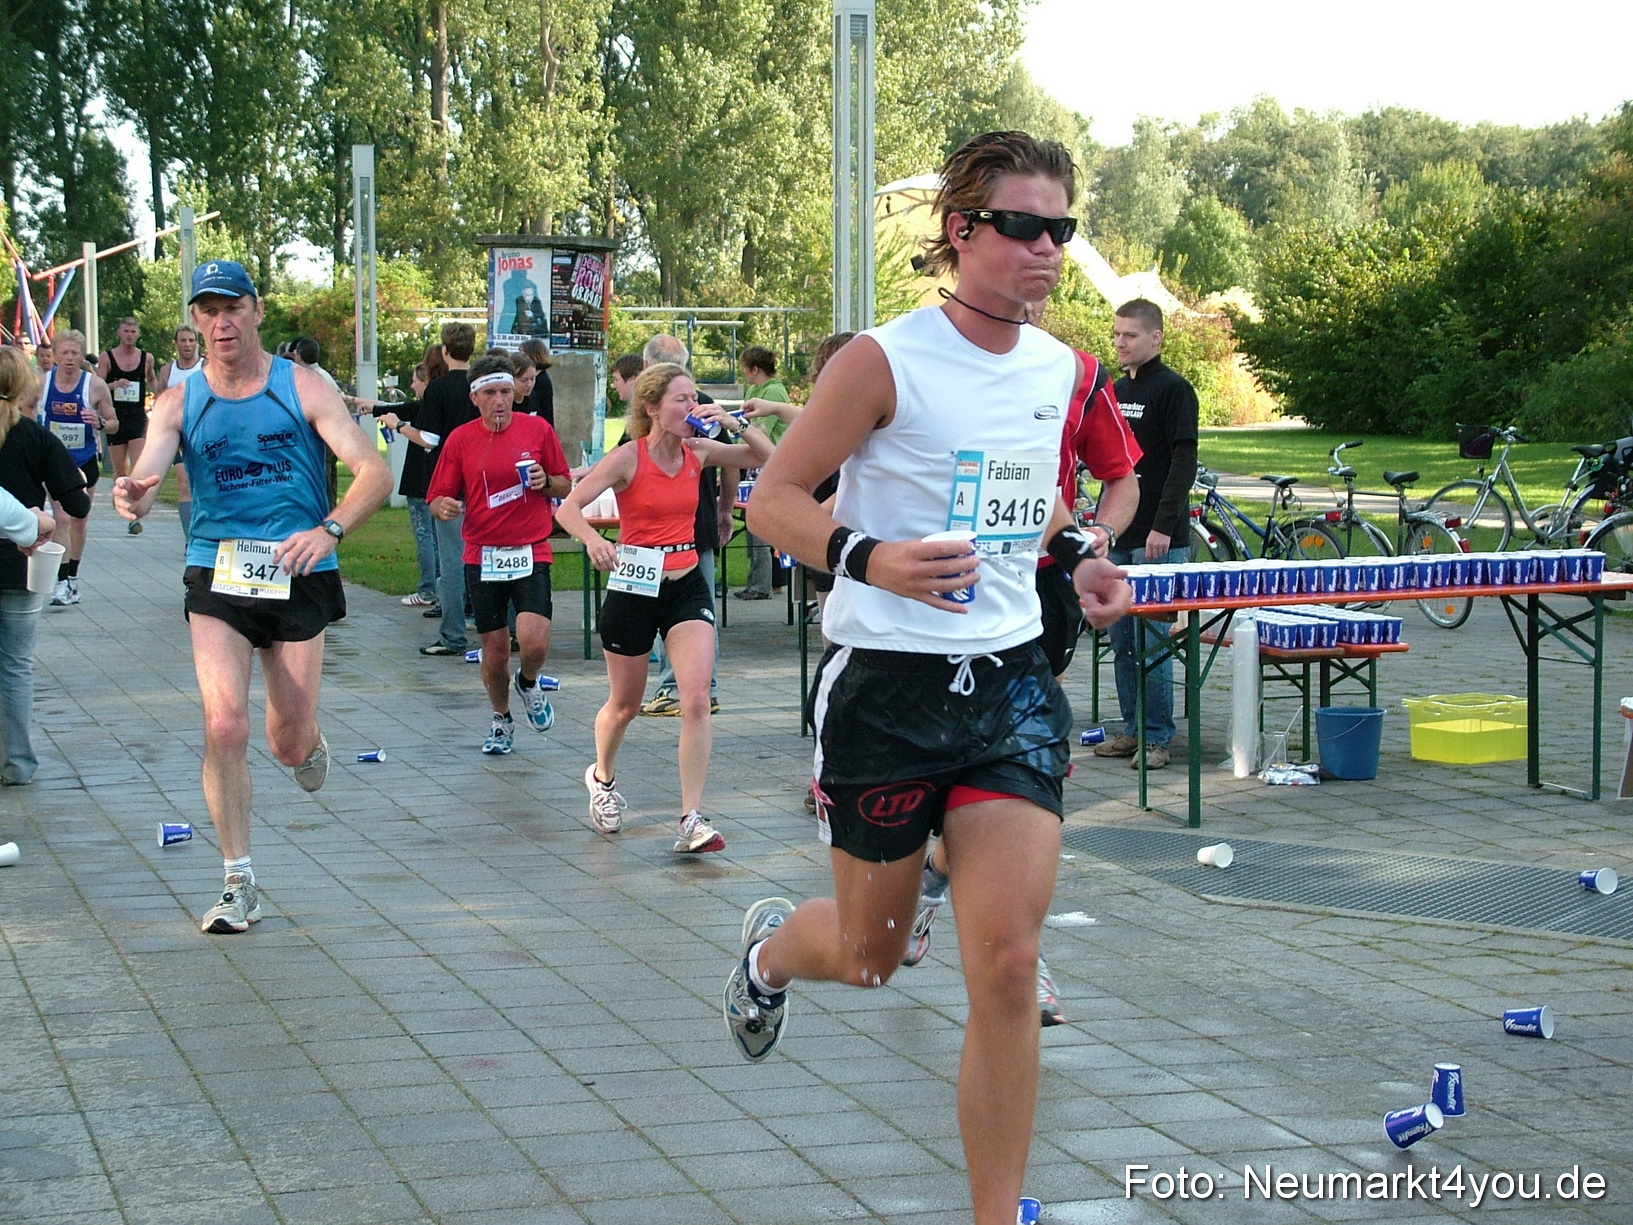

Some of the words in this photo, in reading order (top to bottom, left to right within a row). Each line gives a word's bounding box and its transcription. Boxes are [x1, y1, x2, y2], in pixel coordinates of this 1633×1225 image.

[62, 433, 79, 442] 997
[215, 467, 244, 484] EURO
[266, 460, 292, 475] PLUS
[987, 460, 1030, 480] Fabian
[956, 491, 964, 506] A
[985, 498, 1046, 527] 3416
[237, 540, 271, 554] Helmut
[243, 562, 279, 581] 347
[496, 556, 529, 569] 2488
[619, 561, 657, 581] 2995
[870, 788, 925, 817] LTD
